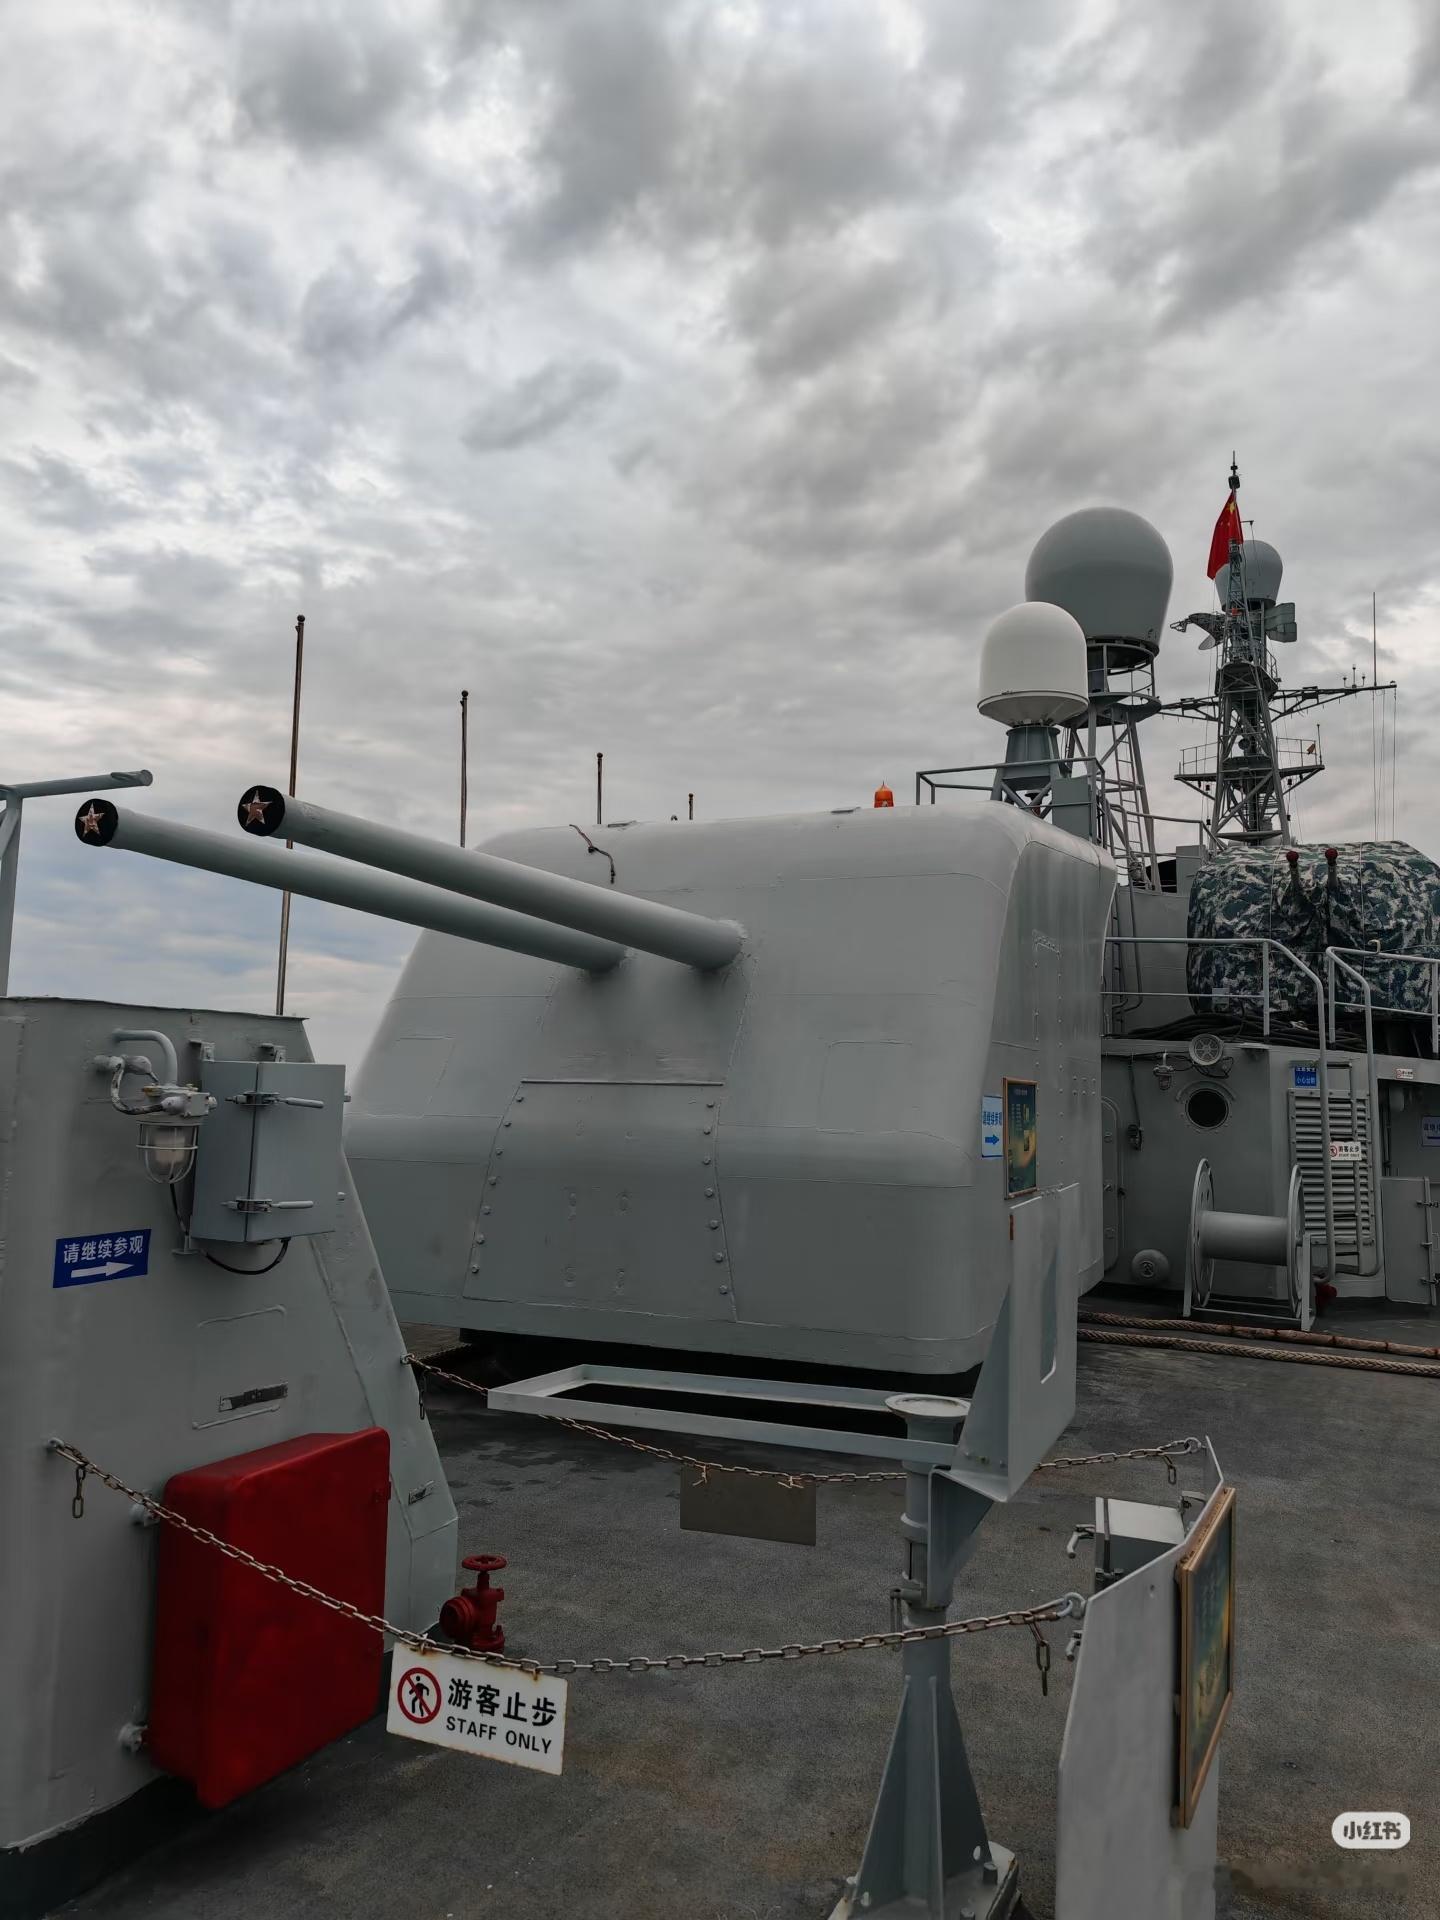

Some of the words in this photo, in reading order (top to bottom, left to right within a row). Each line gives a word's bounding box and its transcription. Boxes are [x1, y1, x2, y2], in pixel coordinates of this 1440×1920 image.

[63, 1235, 144, 1264] 请继续参观
[447, 1678, 557, 1727] 游客止步
[446, 1716, 497, 1741] STAFF
[505, 1730, 552, 1754] ONLY
